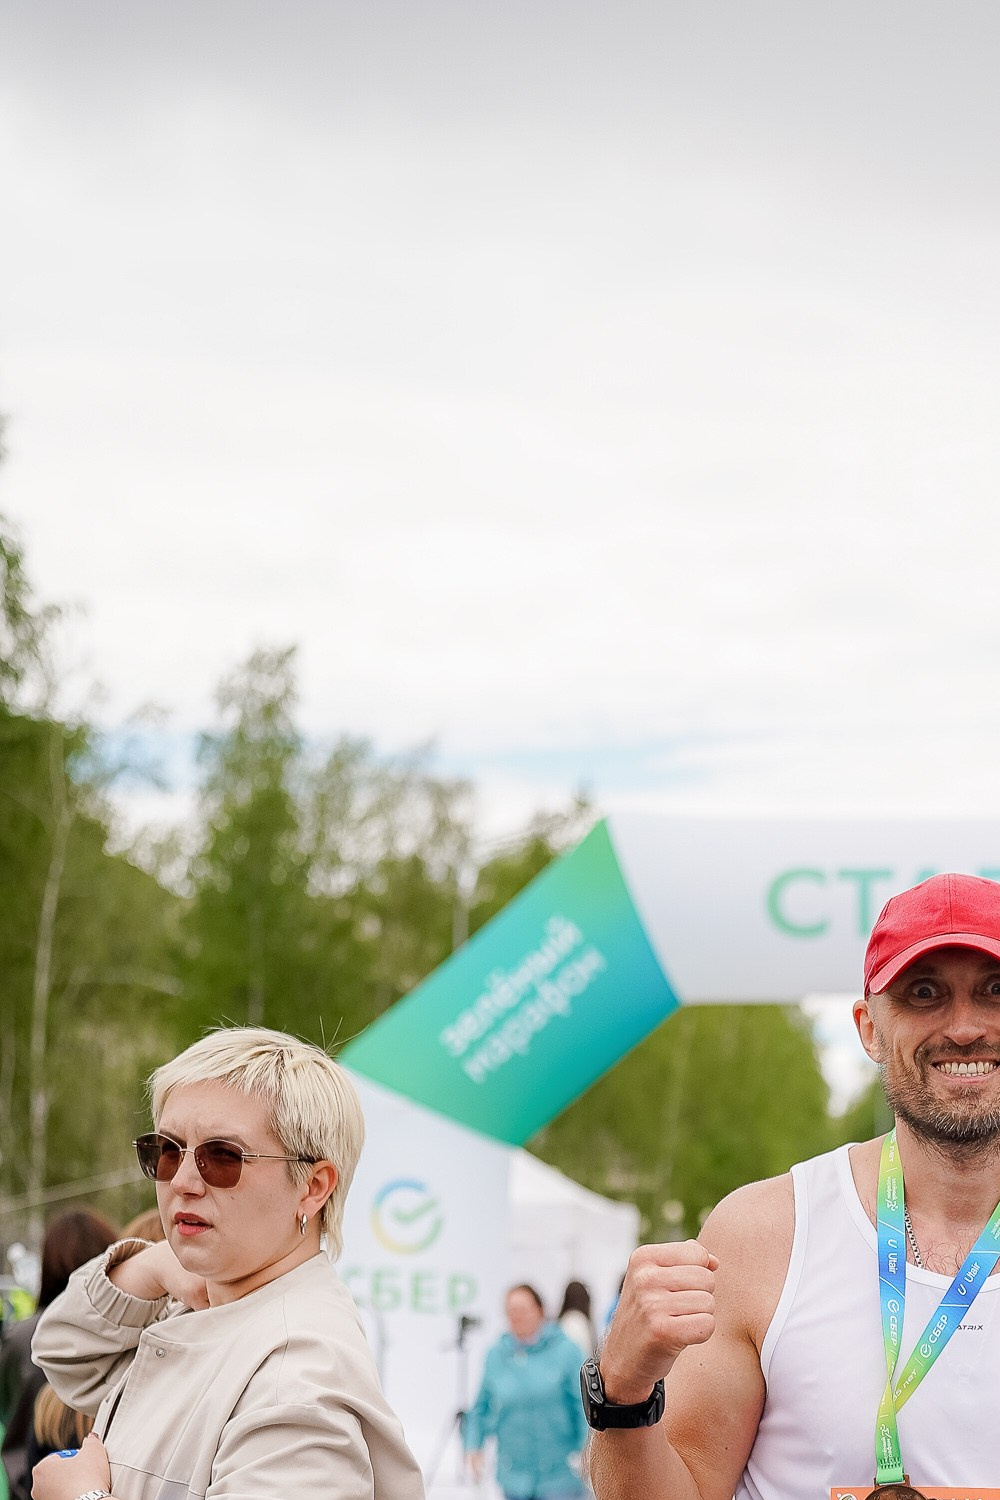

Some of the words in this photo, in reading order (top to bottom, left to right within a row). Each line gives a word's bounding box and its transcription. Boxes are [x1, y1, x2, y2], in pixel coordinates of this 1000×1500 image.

[887, 1252, 898, 1275] Utair
[964, 1262, 981, 1283] Utair
[889, 1314, 898, 1347] СБЕР
[928, 1314, 949, 1344] СБЕР
